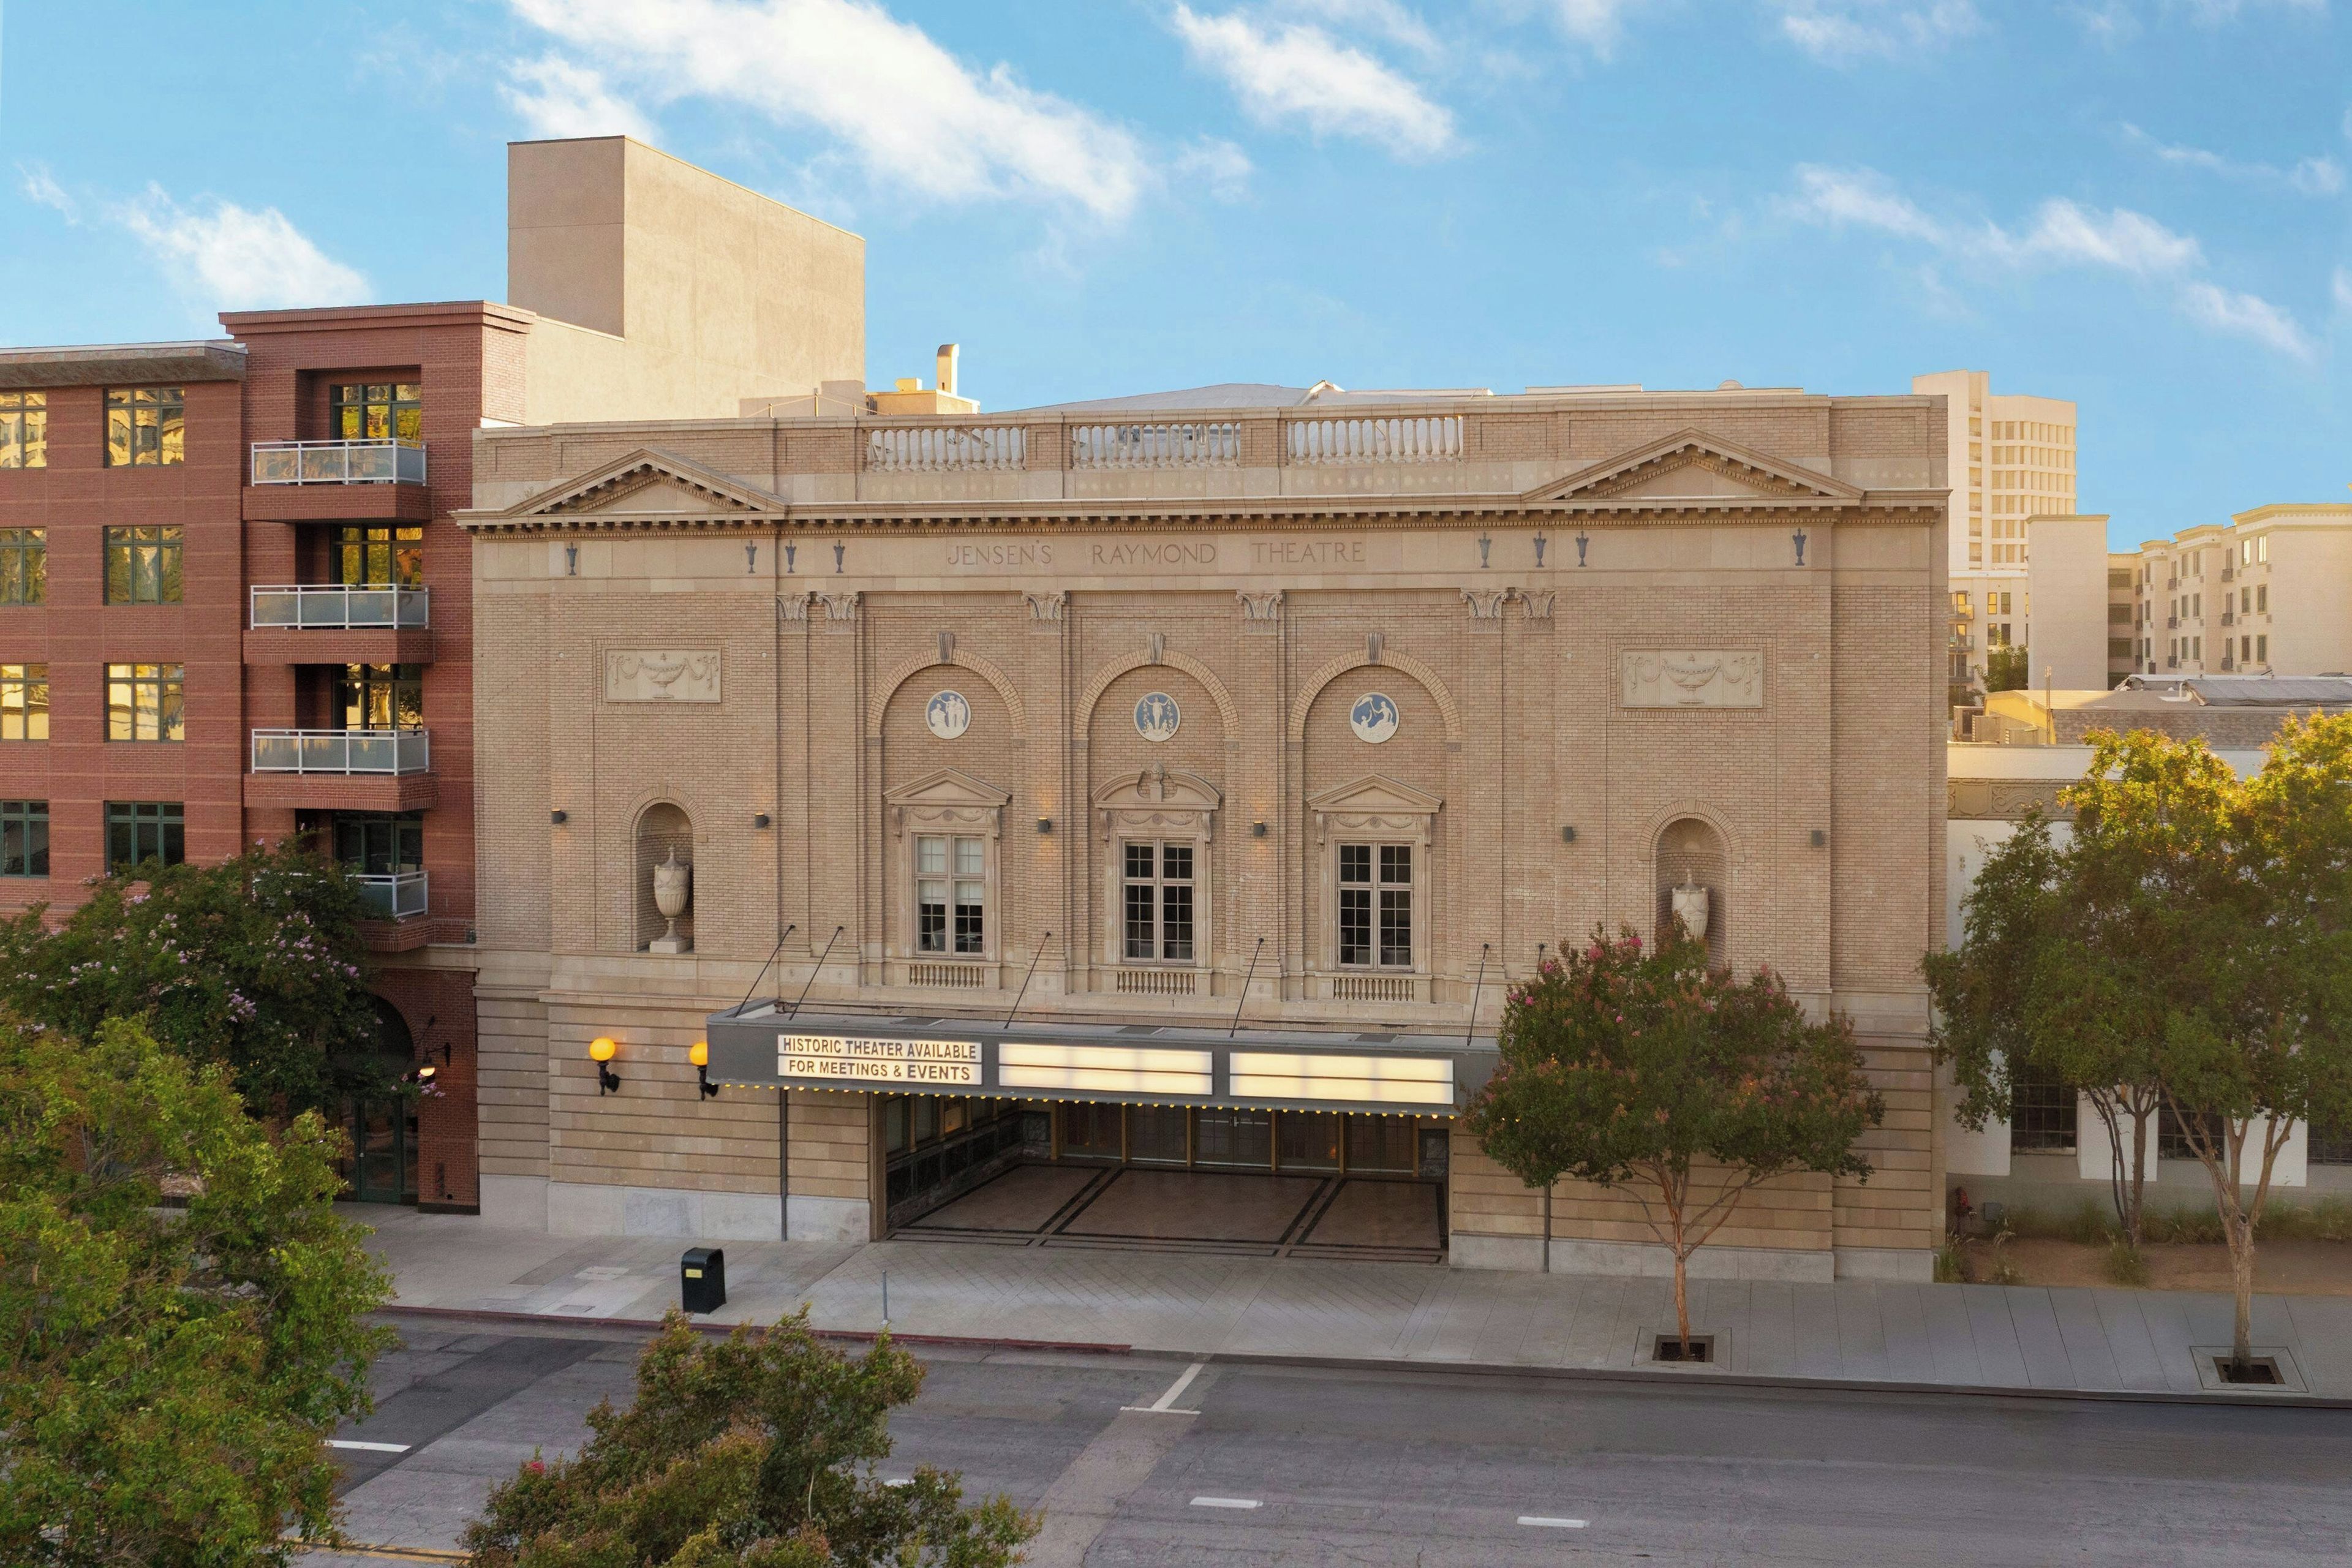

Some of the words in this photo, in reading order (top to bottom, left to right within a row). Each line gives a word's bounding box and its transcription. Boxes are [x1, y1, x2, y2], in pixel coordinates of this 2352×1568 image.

[1092, 543, 1216, 564] RAYMOND
[1251, 541, 1365, 562] THEATRE
[783, 1038, 842, 1054] HISTORIC
[845, 1040, 903, 1057] THEATER
[907, 1042, 976, 1059] AVAILABLE
[789, 1060, 815, 1072] FOR
[820, 1061, 888, 1077] MEETINGS
[893, 1065, 902, 1077] &
[907, 1064, 970, 1080] EVENTS
